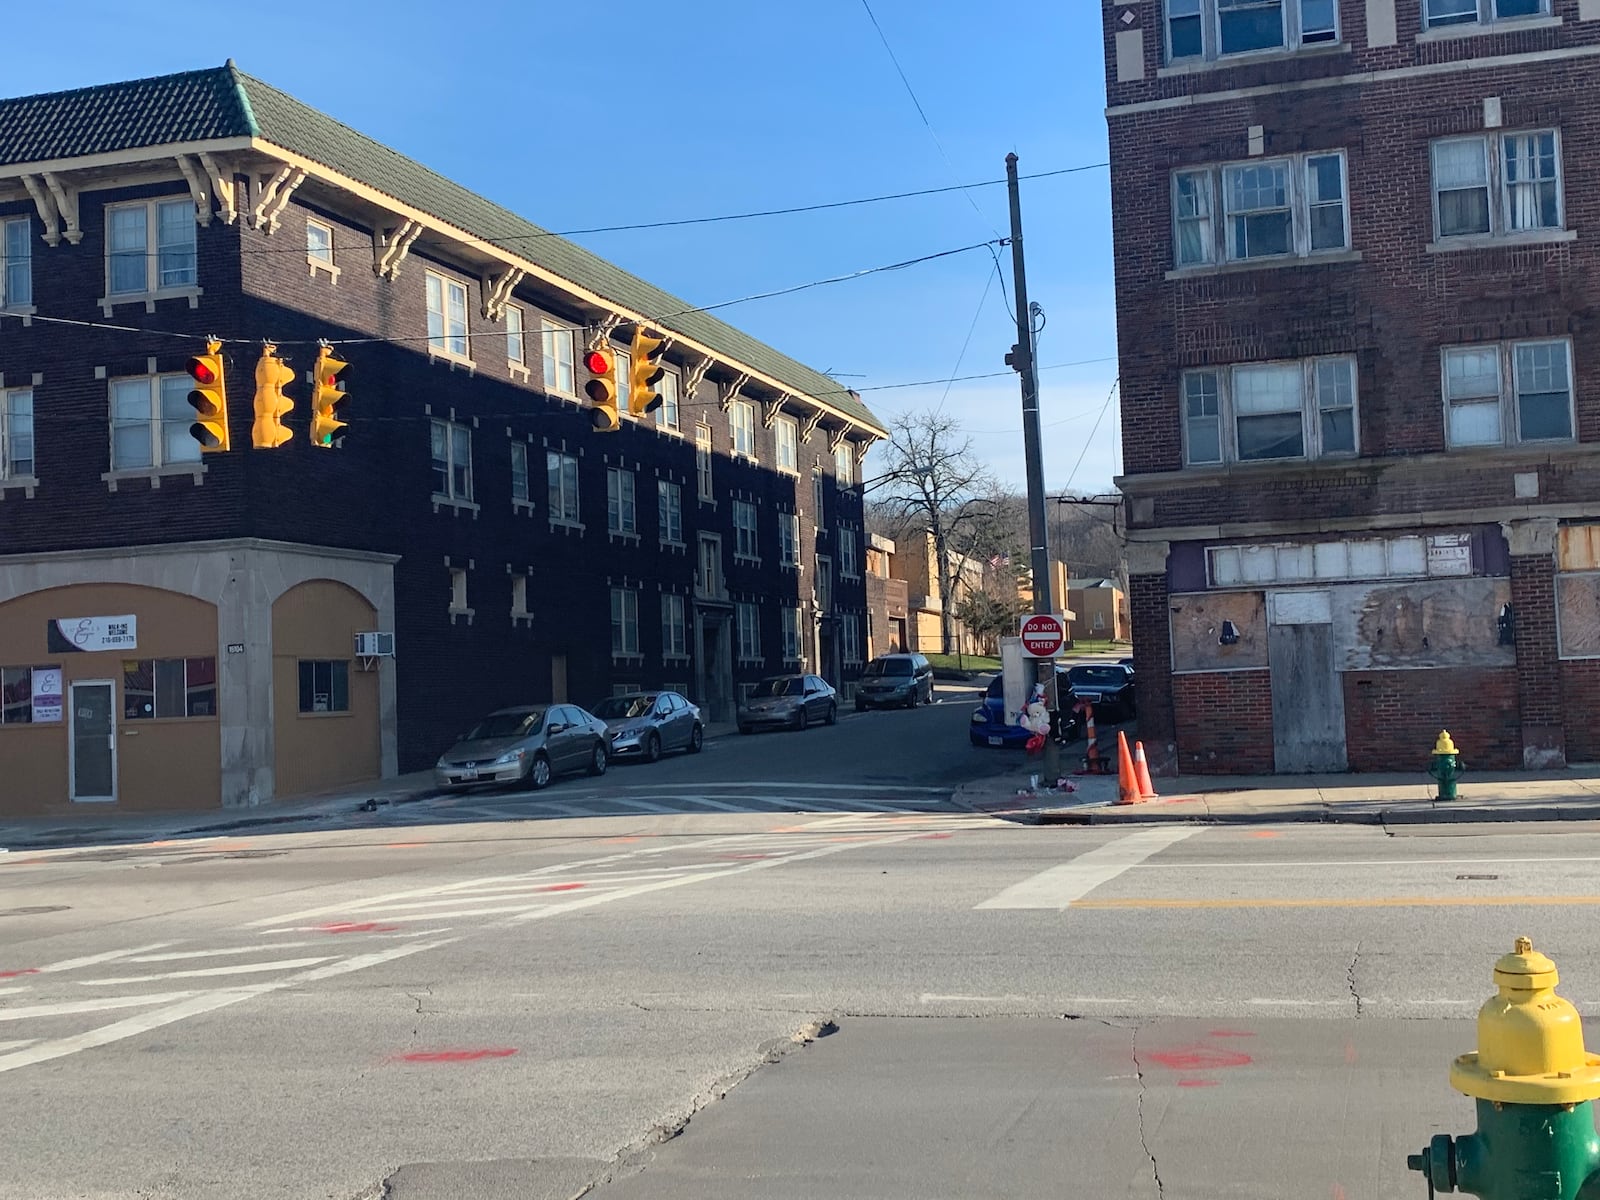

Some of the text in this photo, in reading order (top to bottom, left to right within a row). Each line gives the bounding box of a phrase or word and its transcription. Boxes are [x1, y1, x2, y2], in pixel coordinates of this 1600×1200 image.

[1027, 623, 1057, 631] DO NOT
[1030, 641, 1055, 649] ENTER
